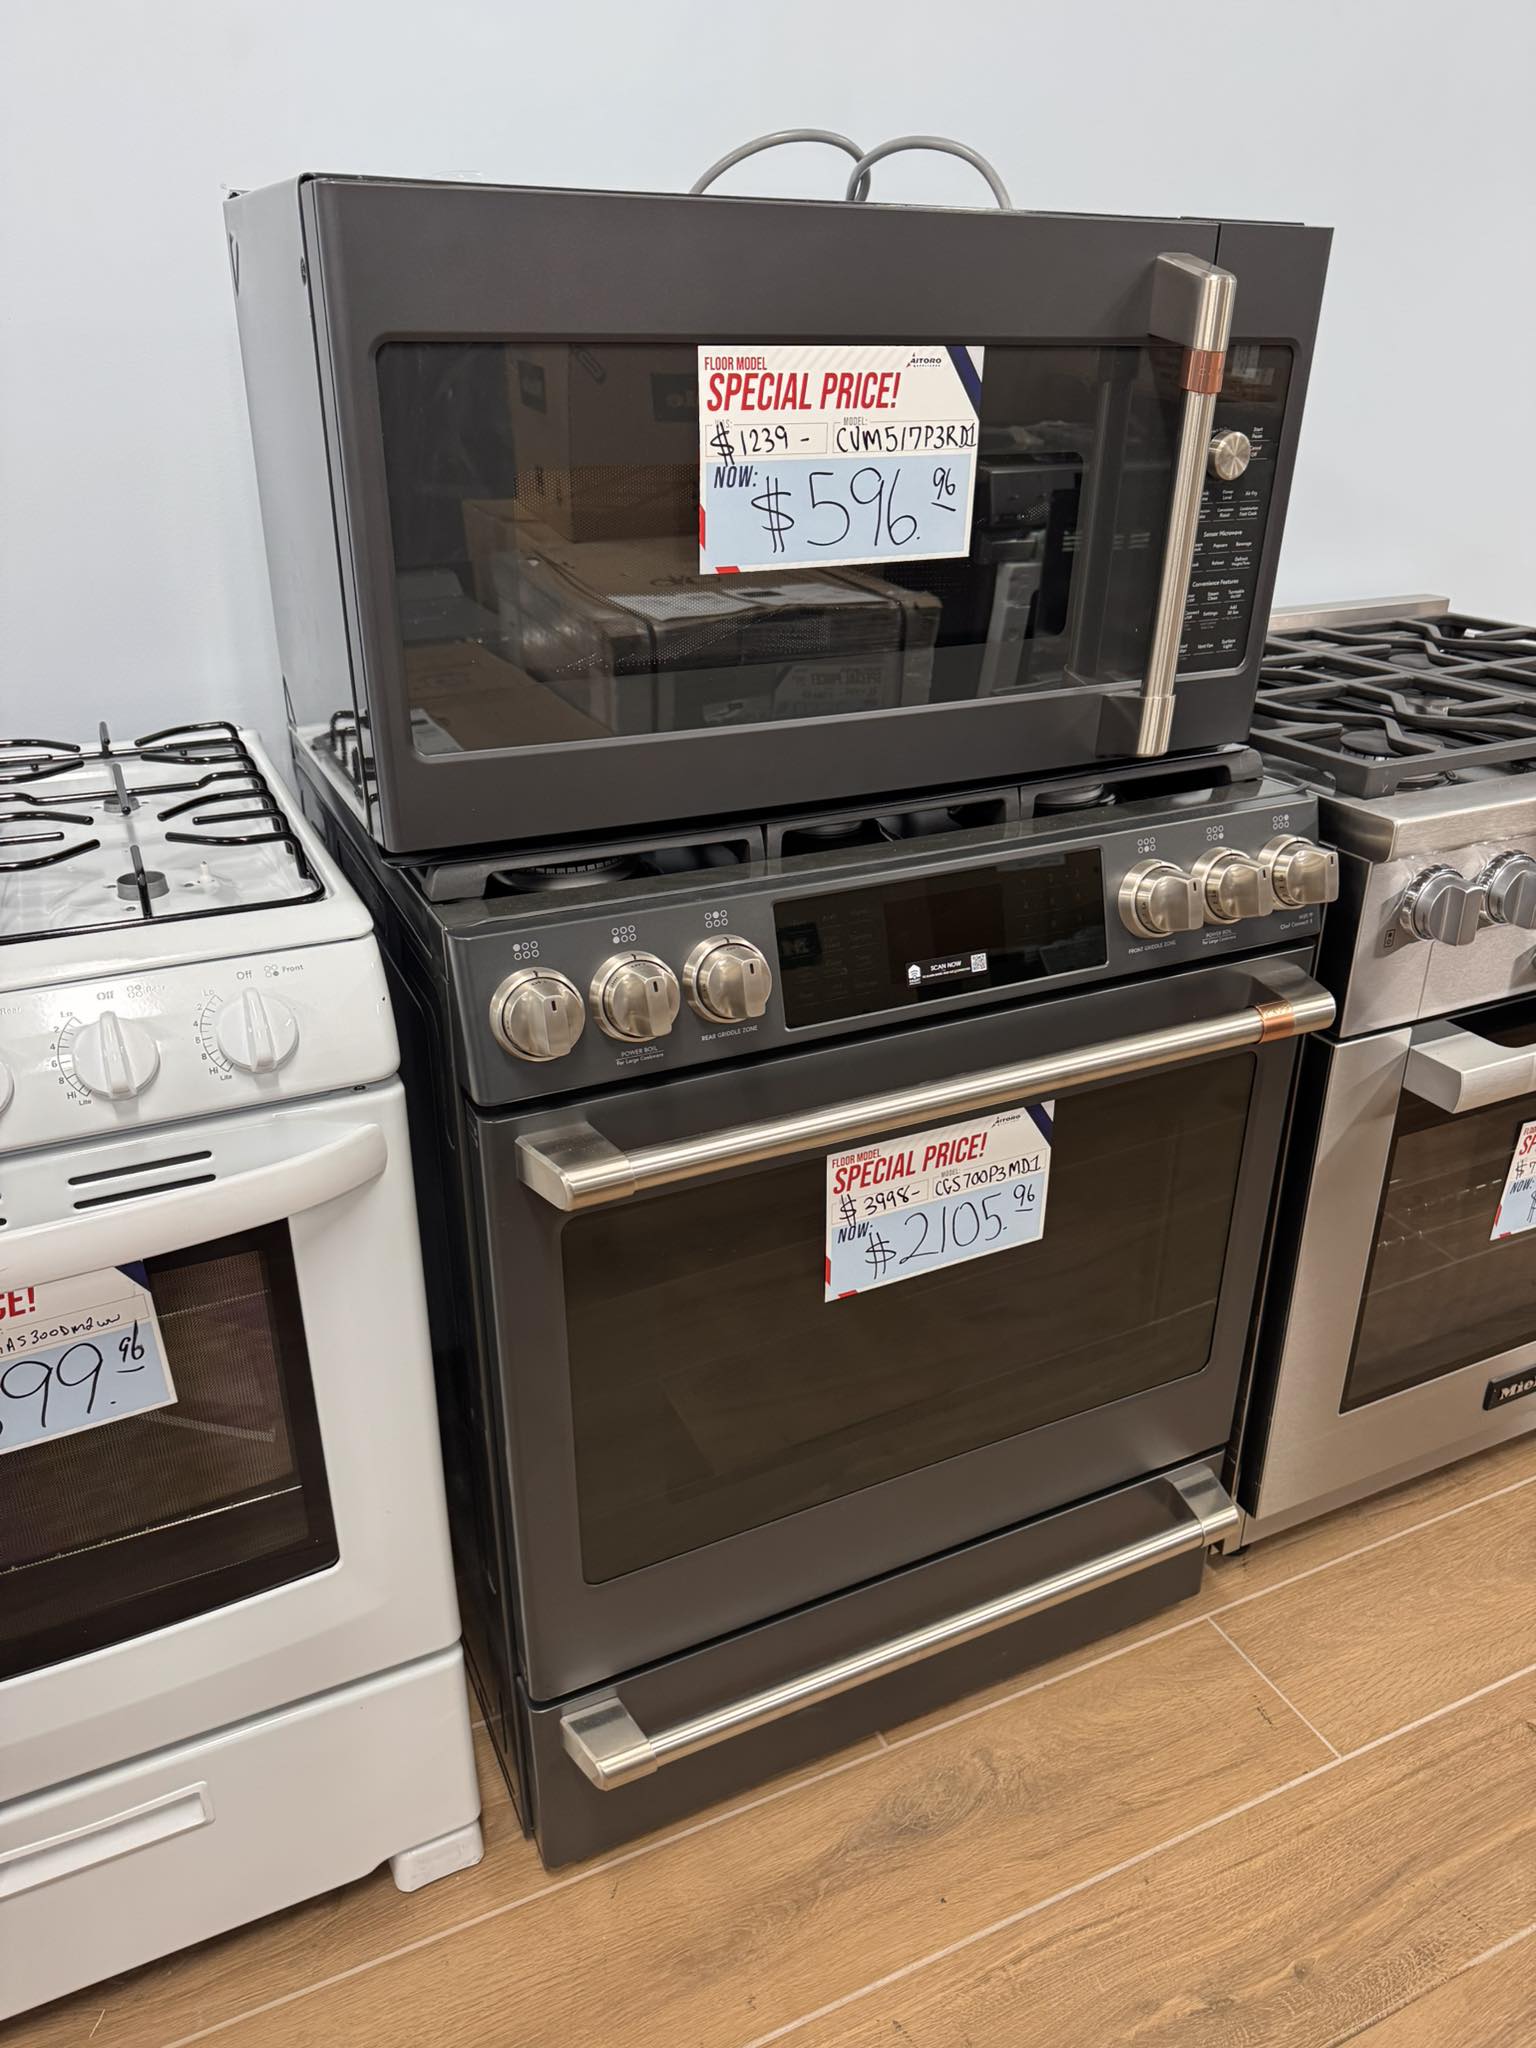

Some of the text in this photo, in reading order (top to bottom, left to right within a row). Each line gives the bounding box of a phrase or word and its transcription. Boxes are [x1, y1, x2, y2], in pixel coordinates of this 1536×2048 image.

[704, 356, 768, 371] FLOOR MODEL
[908, 355, 942, 366] AITORO
[706, 372, 812, 412] SPECIAL
[819, 372, 902, 410] PRICE!
[843, 416, 868, 426] MODEL:
[714, 465, 759, 488] NOW:
[282, 964, 304, 973] Front
[930, 960, 962, 972] SCAN NOW
[236, 970, 252, 980] Off
[96, 990, 114, 1000] Off
[197, 1003, 202, 1011] 2
[717, 1028, 741, 1038] GRIDDLE
[742, 1025, 758, 1033] ZONE
[621, 1048, 642, 1058] POWER
[626, 1056, 640, 1065] Large
[209, 1067, 219, 1075] Hi
[67, 1091, 77, 1100] Hi
[832, 1149, 881, 1168] FLOOR MODEL
[832, 1132, 988, 1195] SPECIAL PRICE!
[837, 1222, 874, 1244] NOW:
[1499, 1377, 1536, 1400] Mie
